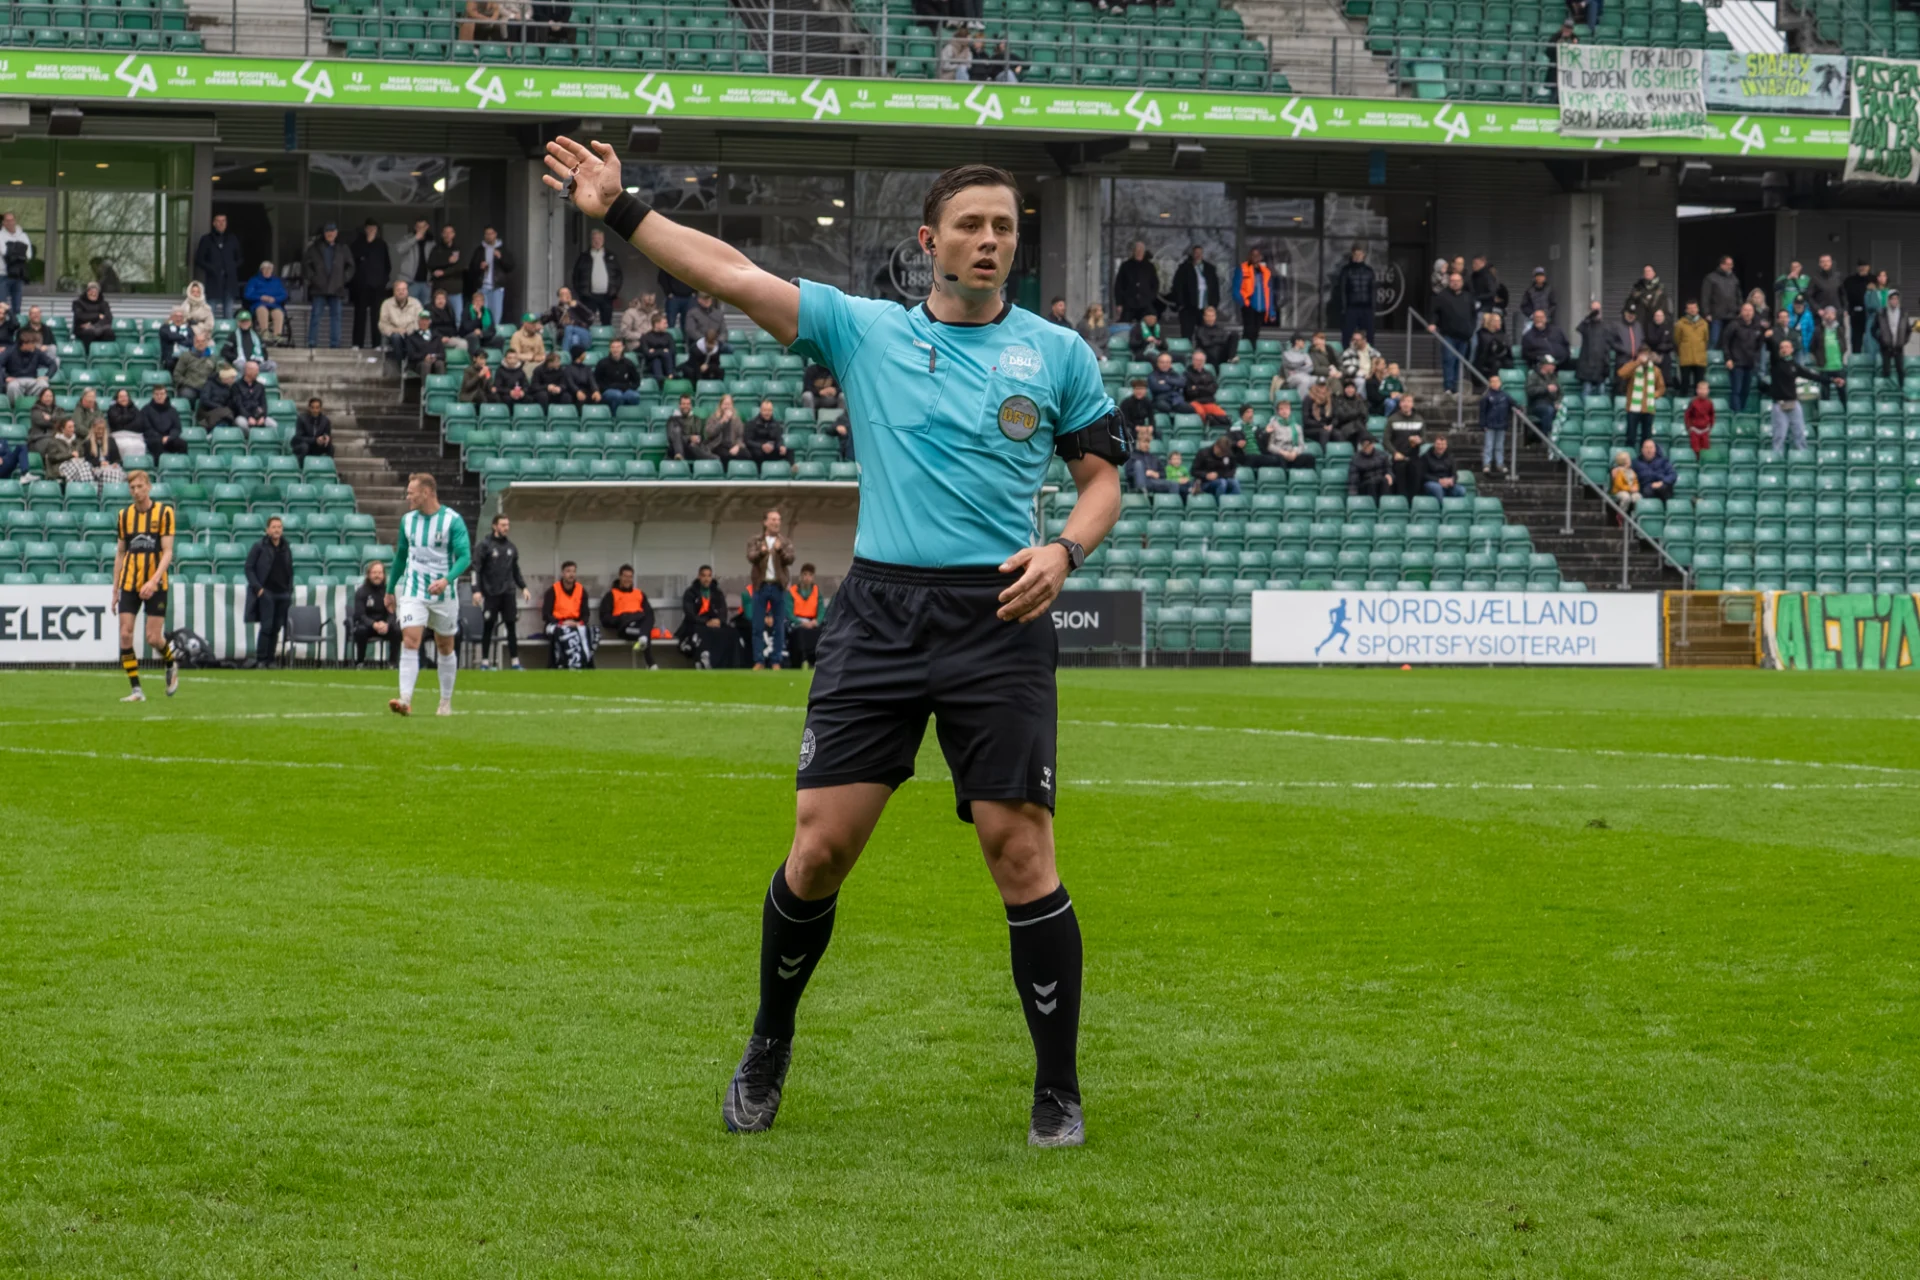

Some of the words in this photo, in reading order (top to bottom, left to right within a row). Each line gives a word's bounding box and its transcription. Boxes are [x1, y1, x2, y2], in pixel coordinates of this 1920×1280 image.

[1746, 53, 1811, 77] SPACEY
[1632, 69, 1651, 88] OS
[1008, 355, 1032, 367] DBU
[1002, 406, 1036, 429] DFU
[1358, 599, 1598, 625] NORDSJÆLLAND
[1357, 635, 1596, 656] SPORTSFYSIOTERAPI
